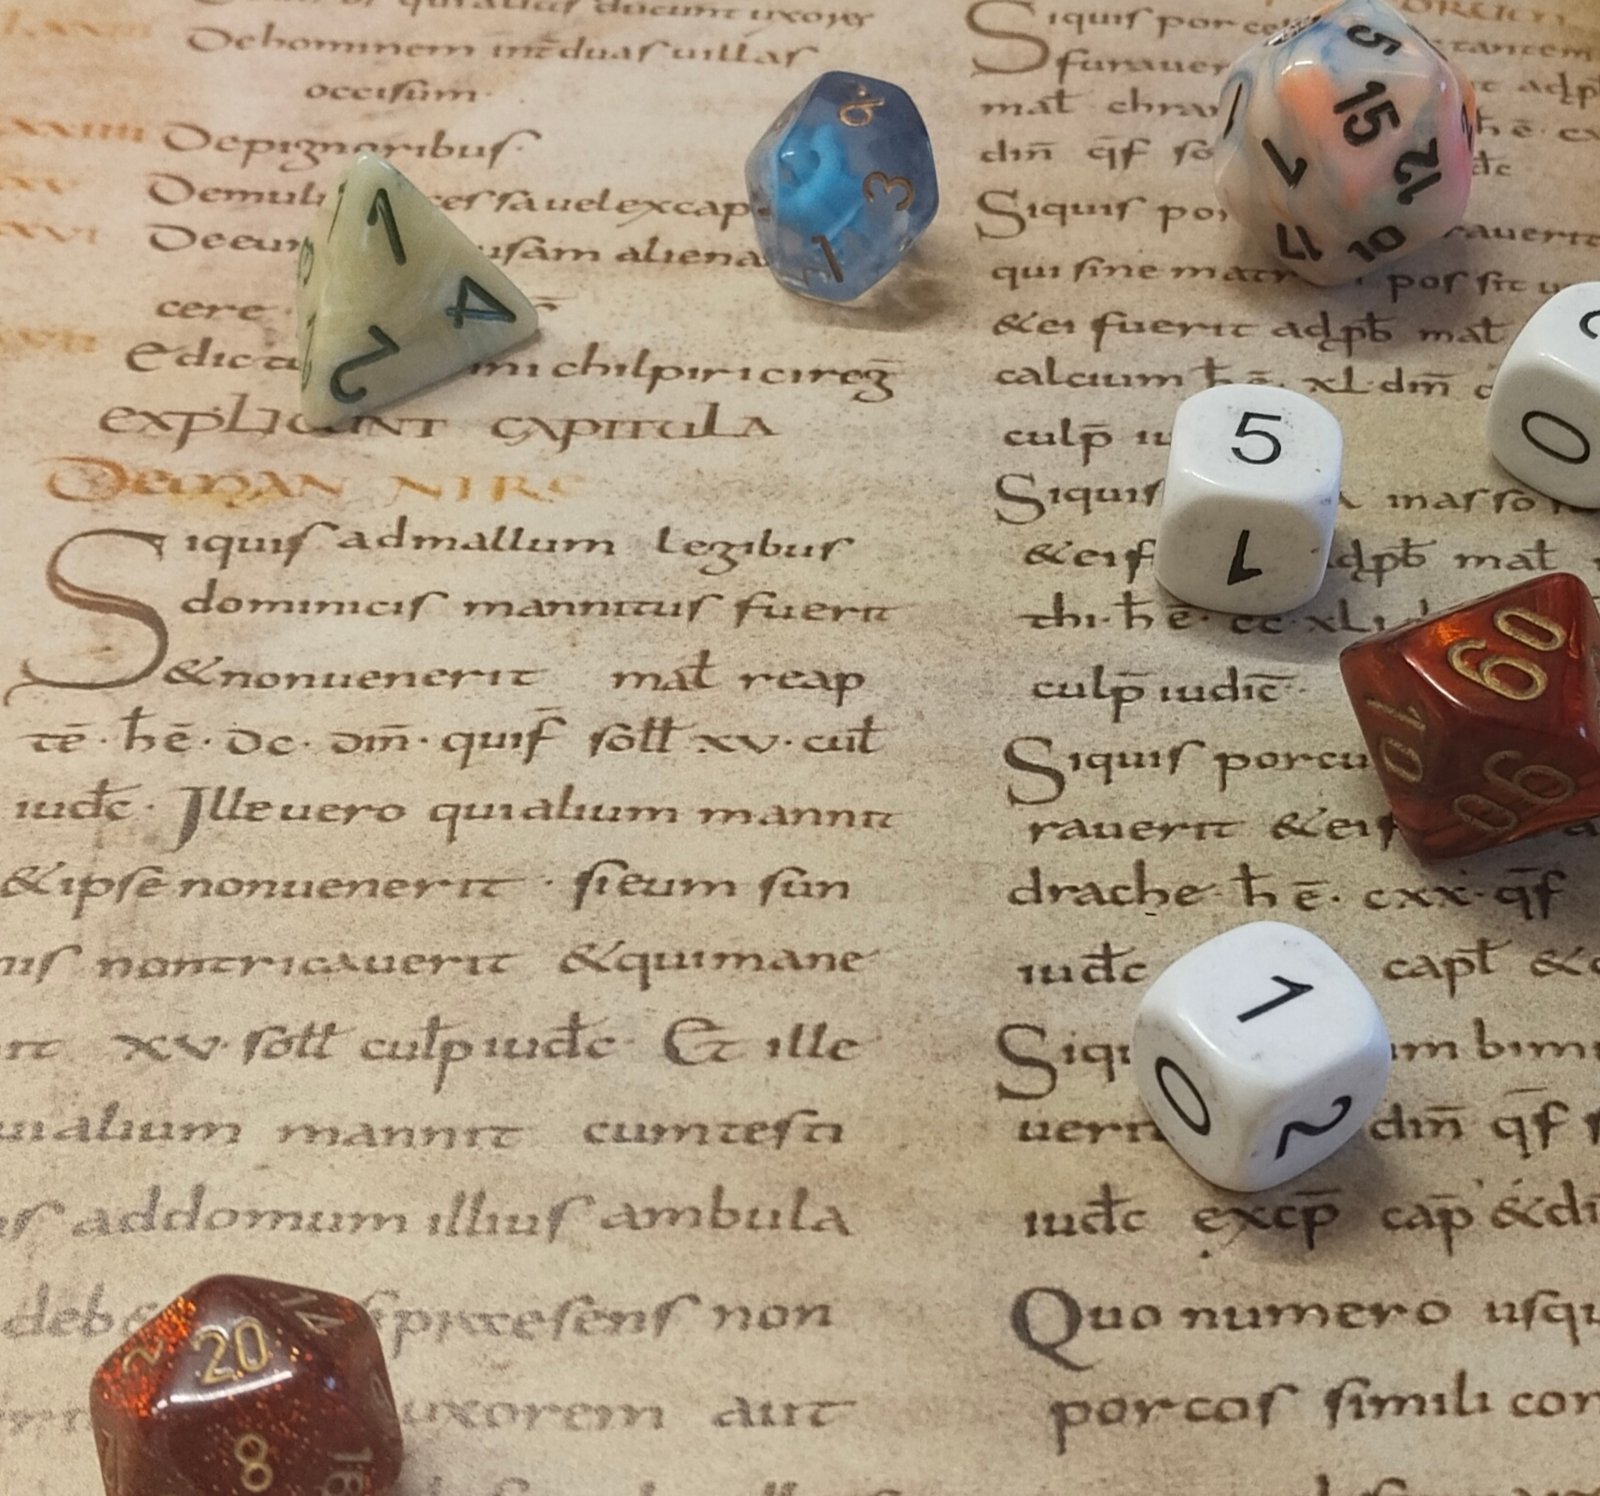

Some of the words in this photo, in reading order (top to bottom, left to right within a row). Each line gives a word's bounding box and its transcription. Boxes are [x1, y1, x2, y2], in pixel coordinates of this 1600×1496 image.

[1346, 25, 1403, 56] 5
[1333, 80, 1400, 147] 15
[862, 170, 916, 212] 3
[366, 187, 407, 266] 1
[810, 234, 845, 284] 1
[445, 275, 518, 328] 4
[330, 324, 400, 403] 2
[1230, 411, 1281, 465] 5
[1520, 410, 1592, 466] 0
[1447, 606, 1567, 701] 60
[1236, 975, 1313, 1024] 1
[1154, 1056, 1212, 1136] 0
[193, 1316, 270, 1386] 20
[233, 1432, 273, 1493] 8
